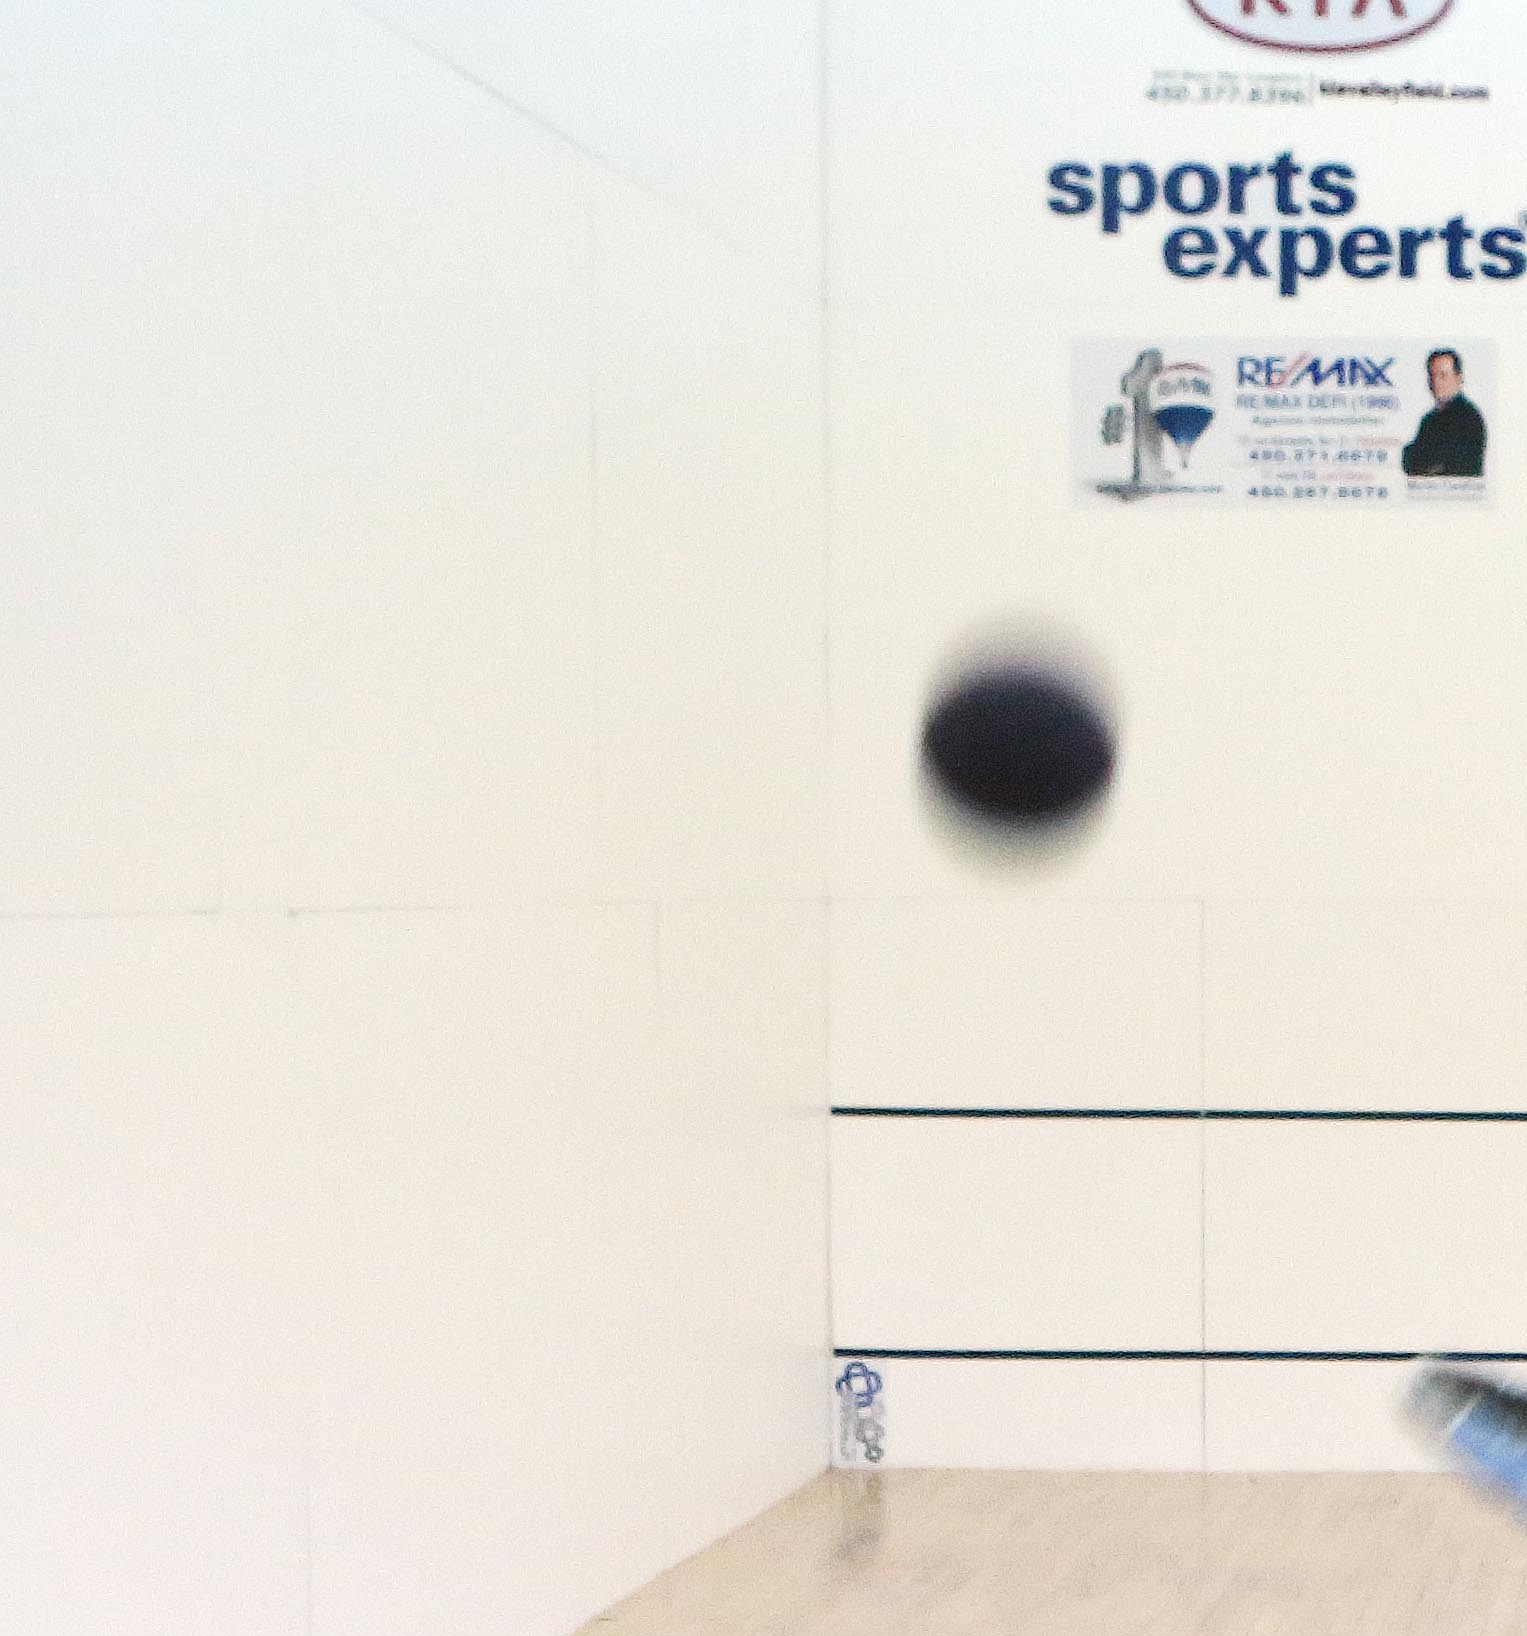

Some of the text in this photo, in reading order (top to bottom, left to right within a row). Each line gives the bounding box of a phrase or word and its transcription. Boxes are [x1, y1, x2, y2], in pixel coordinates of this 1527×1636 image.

[1047, 151, 1357, 233] sports
[1163, 215, 1527, 296] experts
[1236, 353, 1397, 390] RE/MAX
